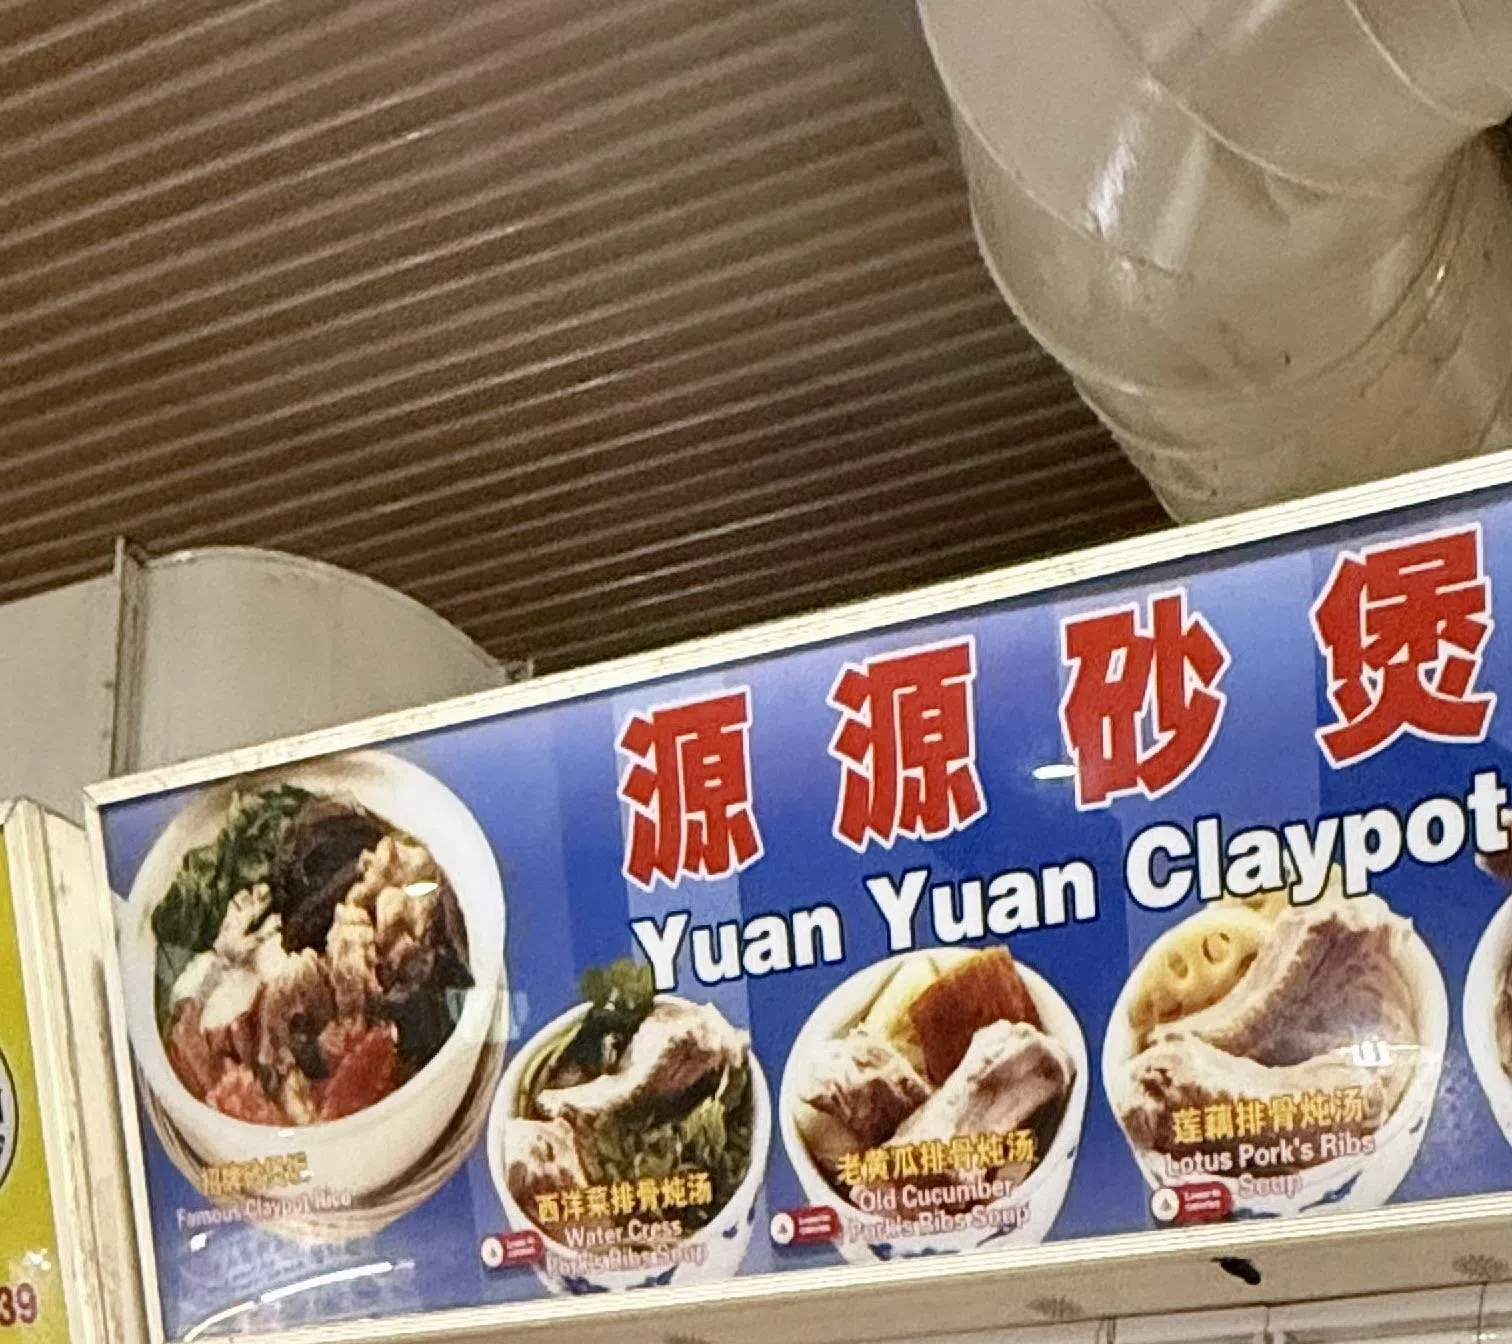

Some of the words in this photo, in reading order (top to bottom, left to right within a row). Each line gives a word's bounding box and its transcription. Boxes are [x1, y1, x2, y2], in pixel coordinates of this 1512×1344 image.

[631, 905, 845, 990] Yuan
[866, 856, 1097, 951] Yuan
[1125, 769, 1508, 912] Claypot
[1165, 1149, 1234, 1179] Lotus
[1238, 1137, 1314, 1169] Pork's
[1319, 1130, 1376, 1159] Ribs
[858, 1188, 898, 1213] Old
[902, 1178, 1013, 1208] Cucumber
[1239, 1173, 1303, 1199] Soup
[245, 1193, 310, 1224] Claypot
[849, 1216, 913, 1243] Pork's
[917, 1208, 967, 1236] Ribs
[971, 1202, 1030, 1230] Soup
[564, 1226, 624, 1249] Water
[628, 1216, 682, 1240] Cress
[608, 1246, 655, 1271] Ribs
[656, 1241, 707, 1268] Soup
